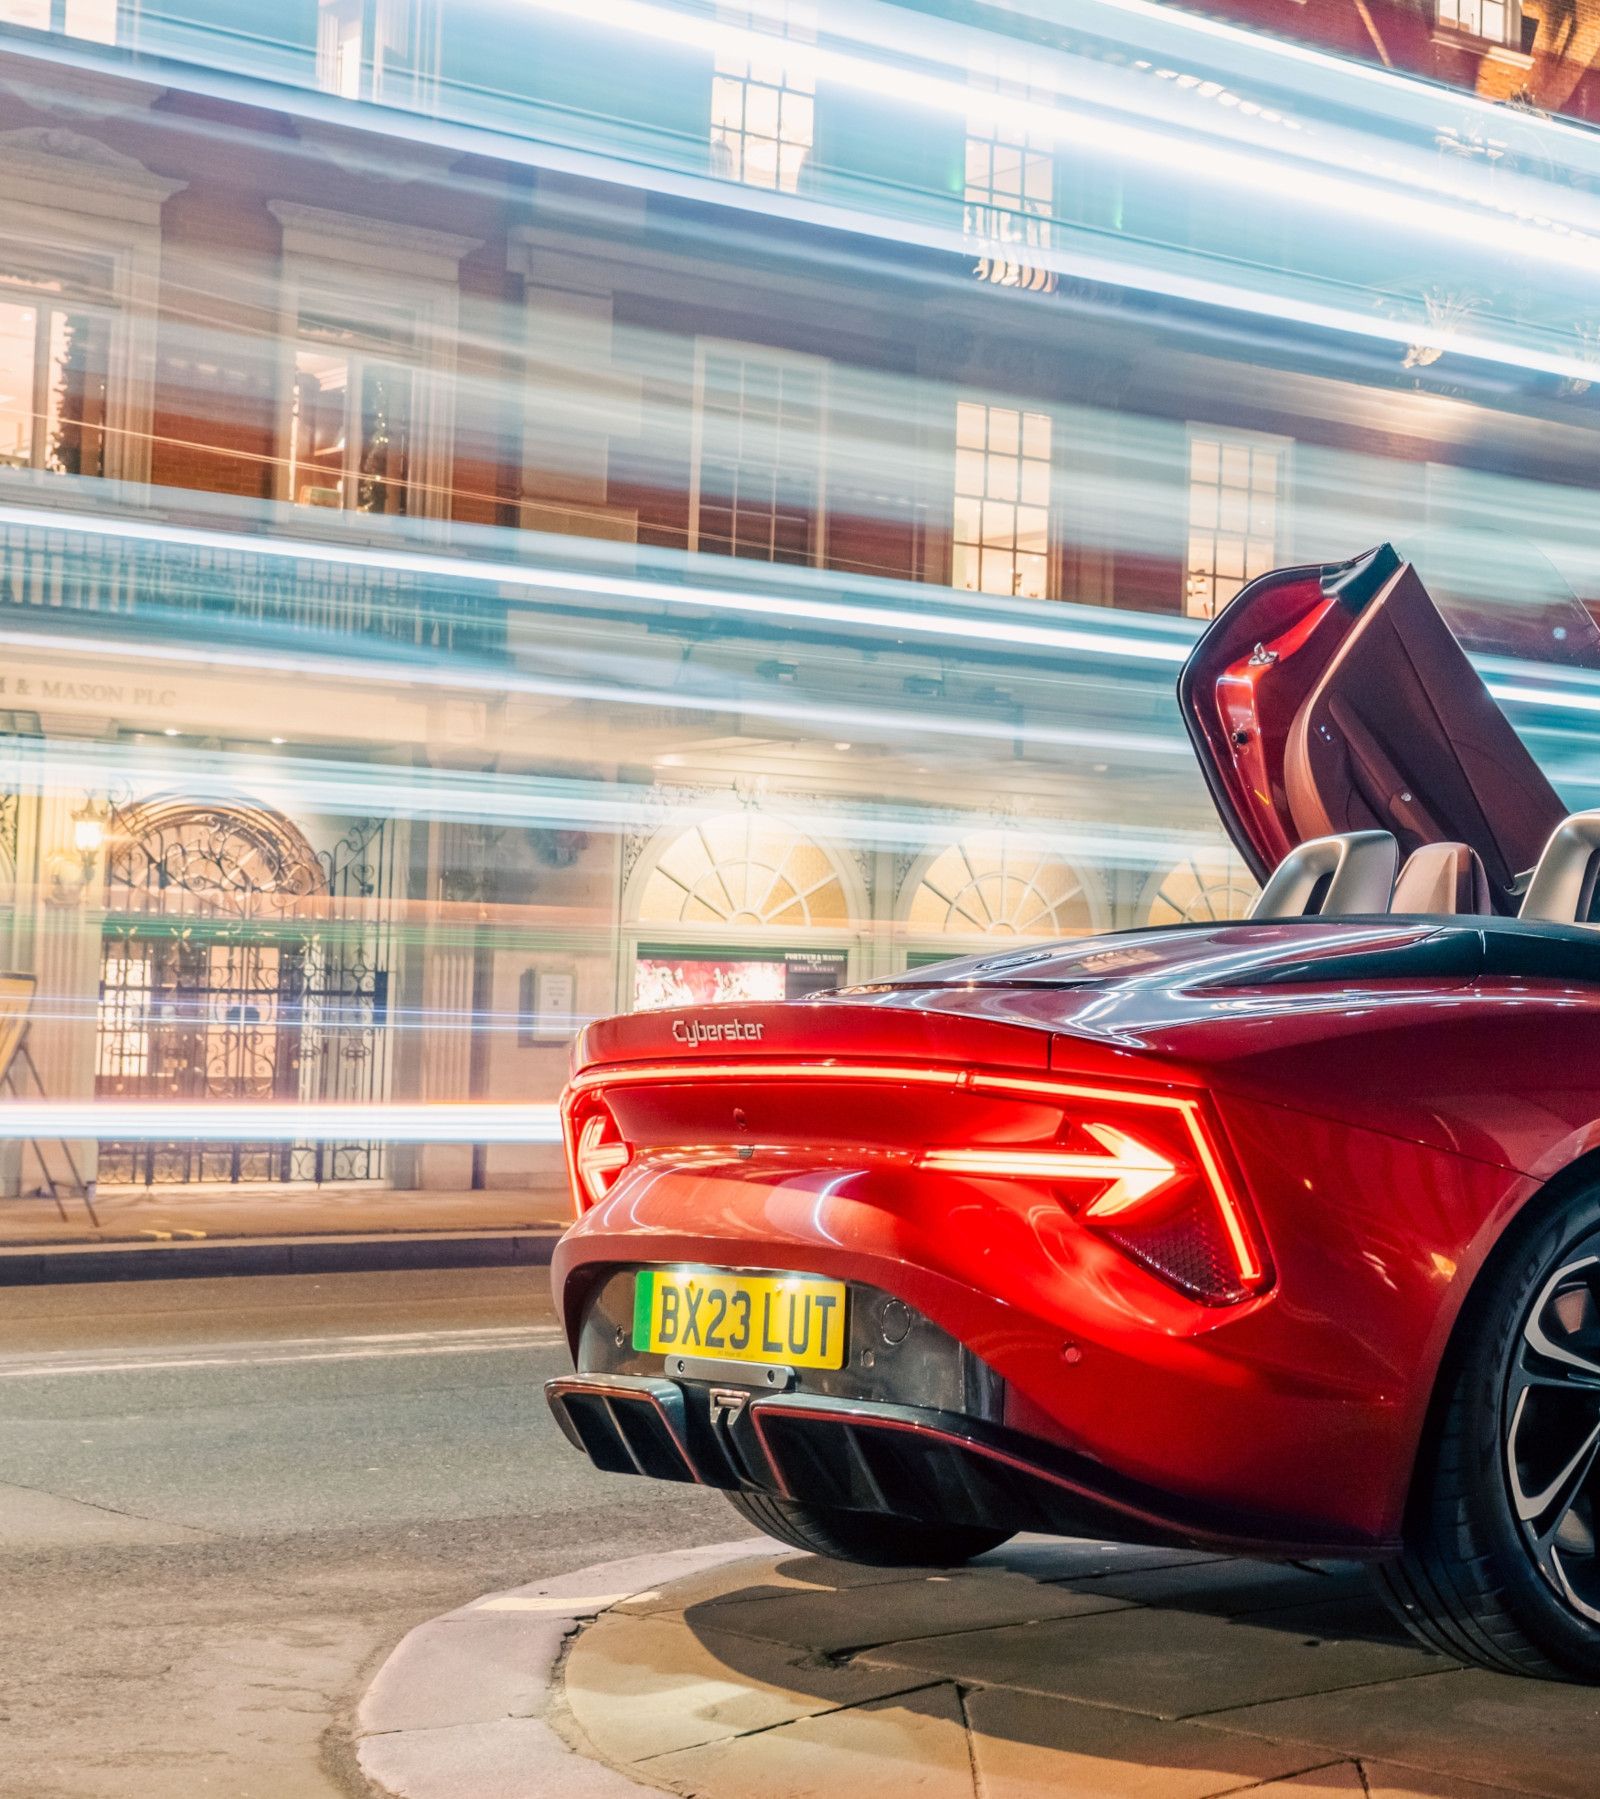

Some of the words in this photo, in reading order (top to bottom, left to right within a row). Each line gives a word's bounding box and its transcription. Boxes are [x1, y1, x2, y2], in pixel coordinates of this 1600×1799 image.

[41, 680, 124, 703] MASON
[133, 688, 177, 706] PLC
[672, 1018, 765, 1048] Cyberster
[658, 1285, 752, 1350] BX23
[762, 1292, 837, 1357] LUT
